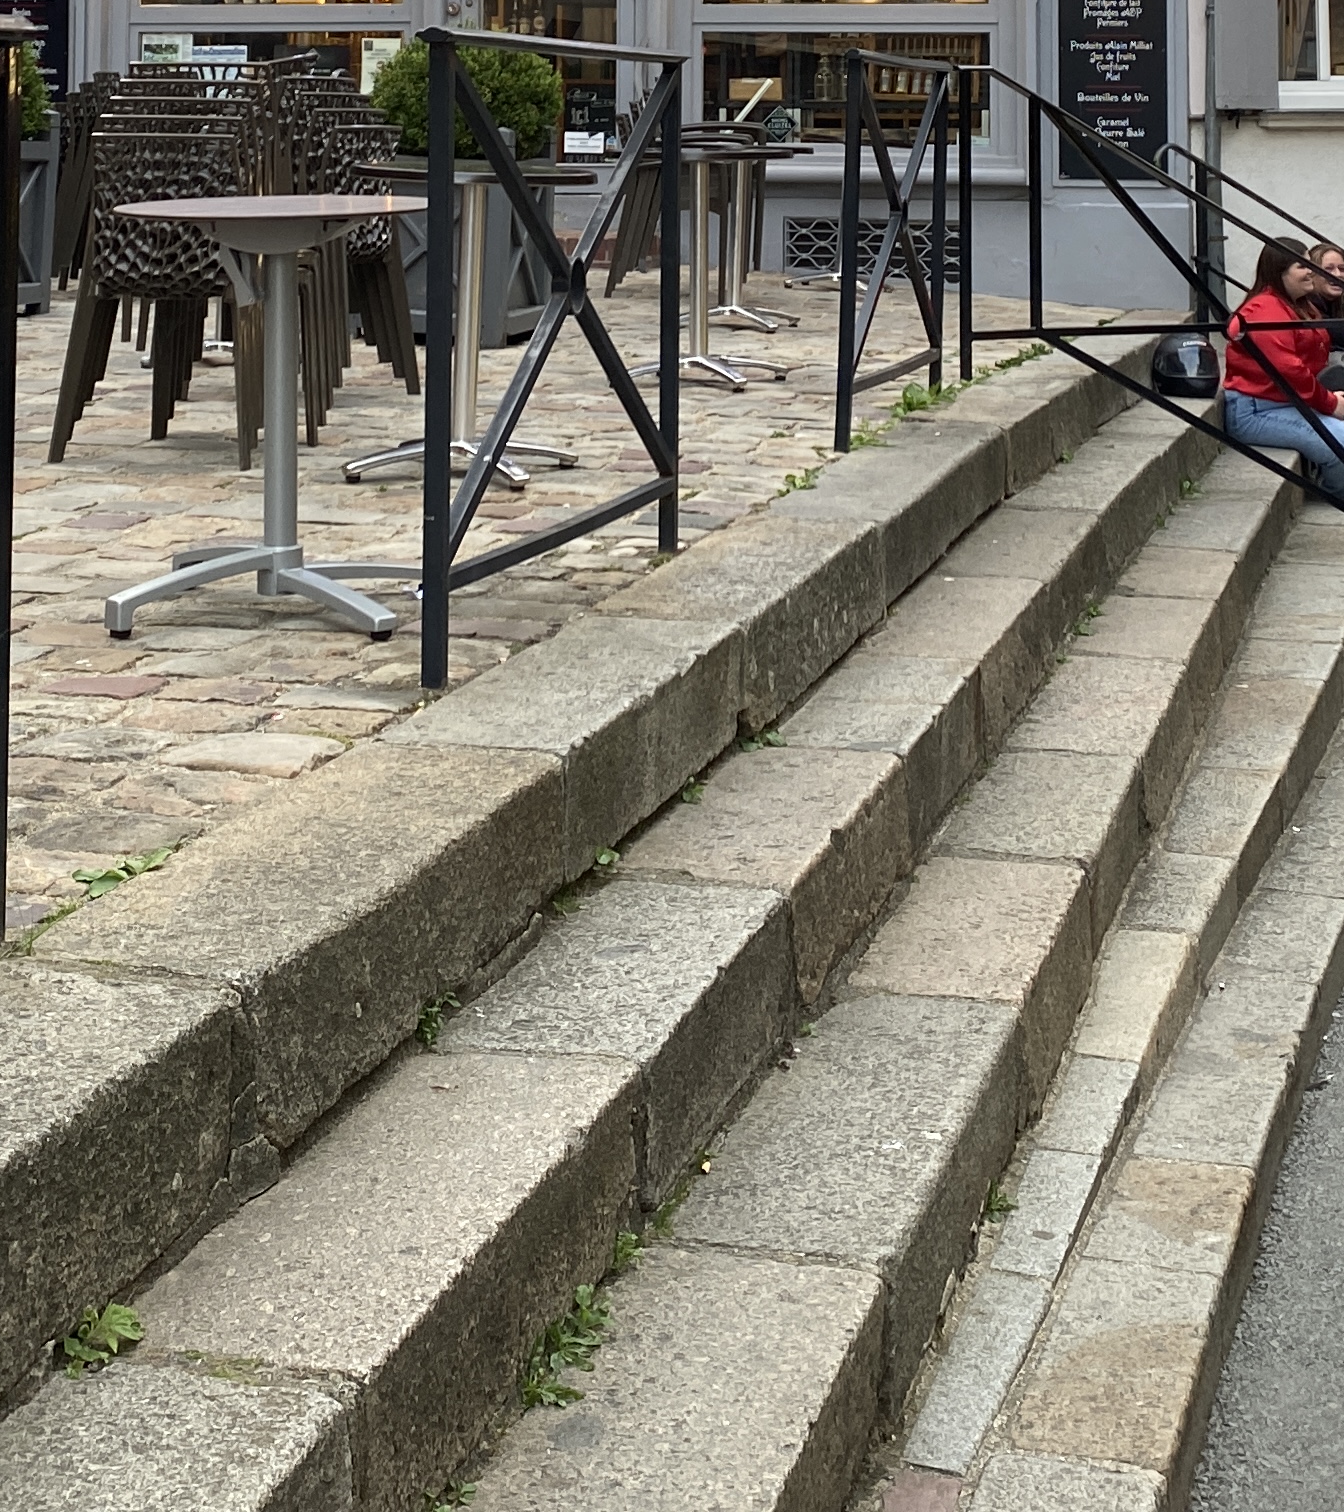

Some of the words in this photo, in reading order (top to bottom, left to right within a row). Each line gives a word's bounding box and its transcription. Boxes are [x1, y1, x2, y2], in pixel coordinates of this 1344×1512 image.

[1077, 92, 1119, 103] Bouteilles
[1121, 92, 1132, 103] de
[1134, 92, 1150, 103] Vin
[1097, 116, 1130, 128] Caramel
